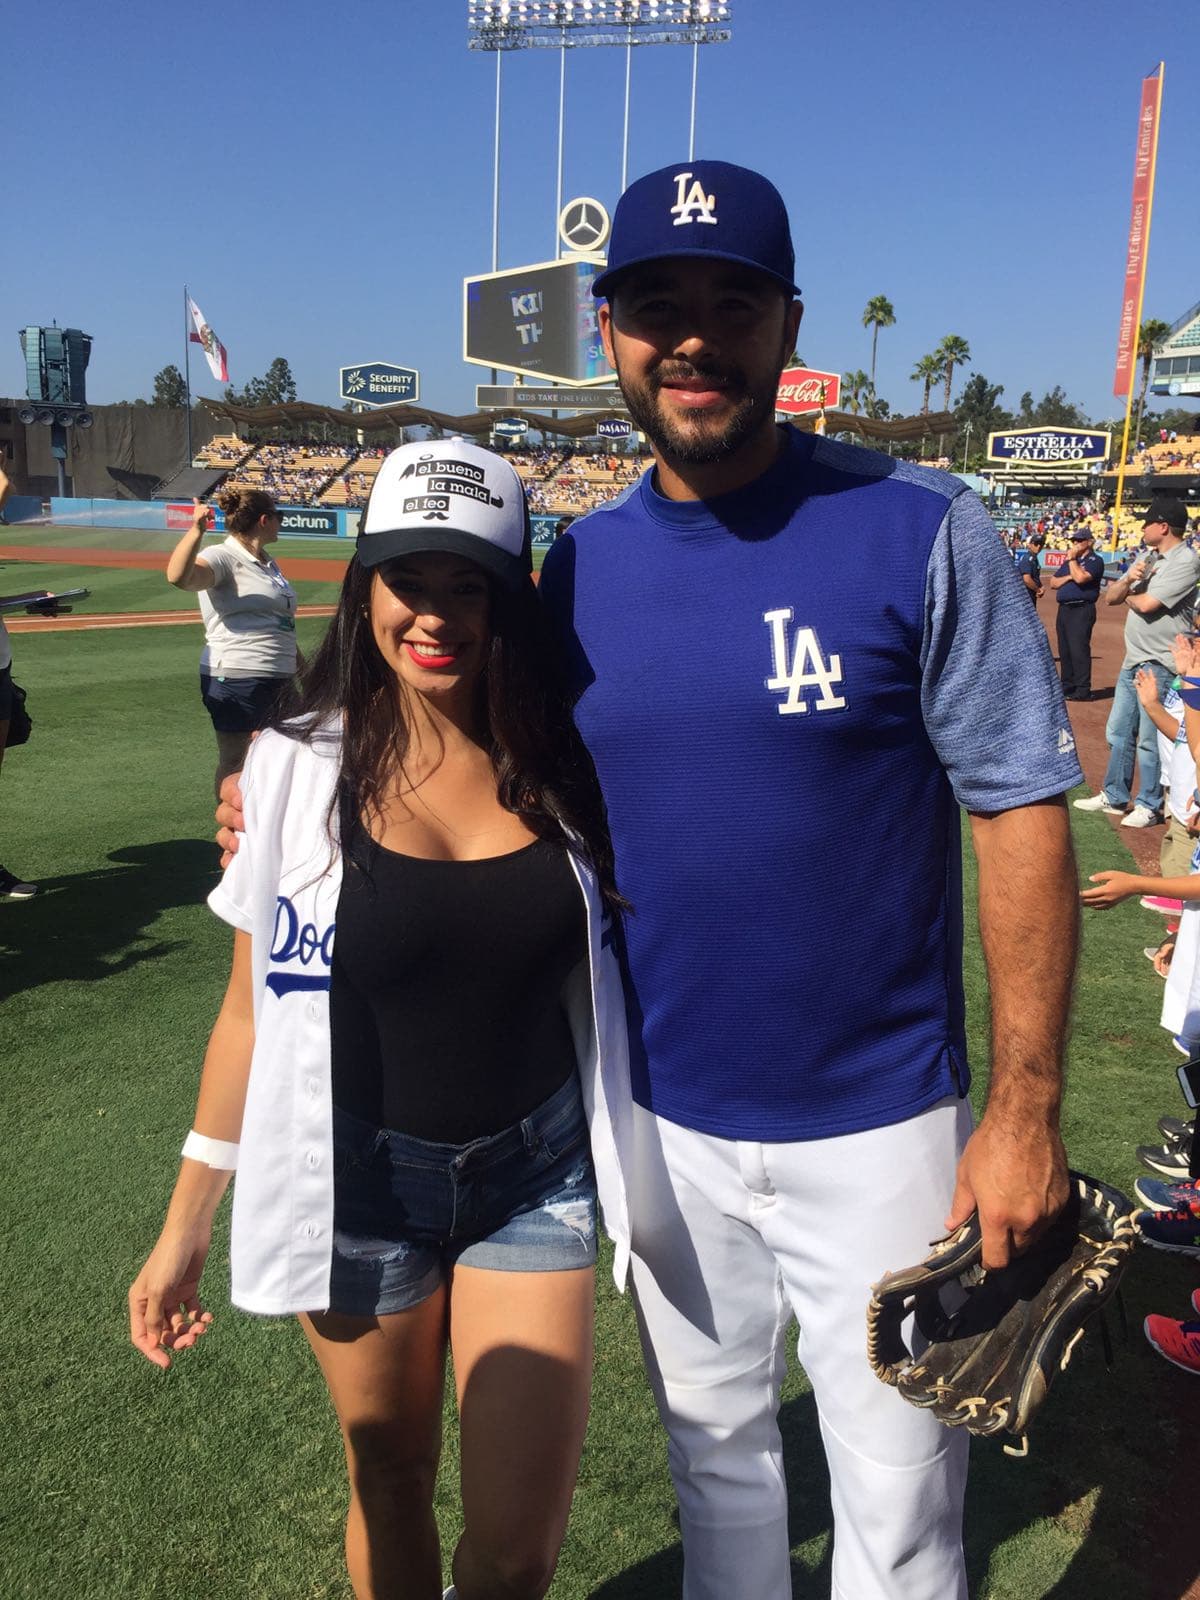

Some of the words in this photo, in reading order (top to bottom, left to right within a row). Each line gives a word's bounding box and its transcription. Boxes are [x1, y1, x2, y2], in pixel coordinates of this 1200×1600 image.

[1139, 105, 1154, 156] Emirates
[1136, 157, 1150, 177] Fly
[670, 172, 718, 226] LA
[1128, 203, 1144, 253] Emirates
[1126, 255, 1141, 274] Fly
[1119, 299, 1135, 348] Emirates
[1116, 351, 1130, 369] Fly
[369, 373, 413, 384] SECURITY
[369, 383, 406, 394] BENEFIT
[537, 393, 558, 402] TAKE
[599, 424, 630, 434] DASANI
[1003, 436, 1094, 449] ESTRELLA
[1010, 448, 1084, 460] JALISCO
[418, 463, 432, 474] el
[436, 461, 482, 481] bueno
[430, 480, 446, 491] la
[450, 484, 488, 502] mala
[406, 498, 419, 511] el
[423, 498, 447, 509] feo
[281, 514, 330, 529] ectrum
